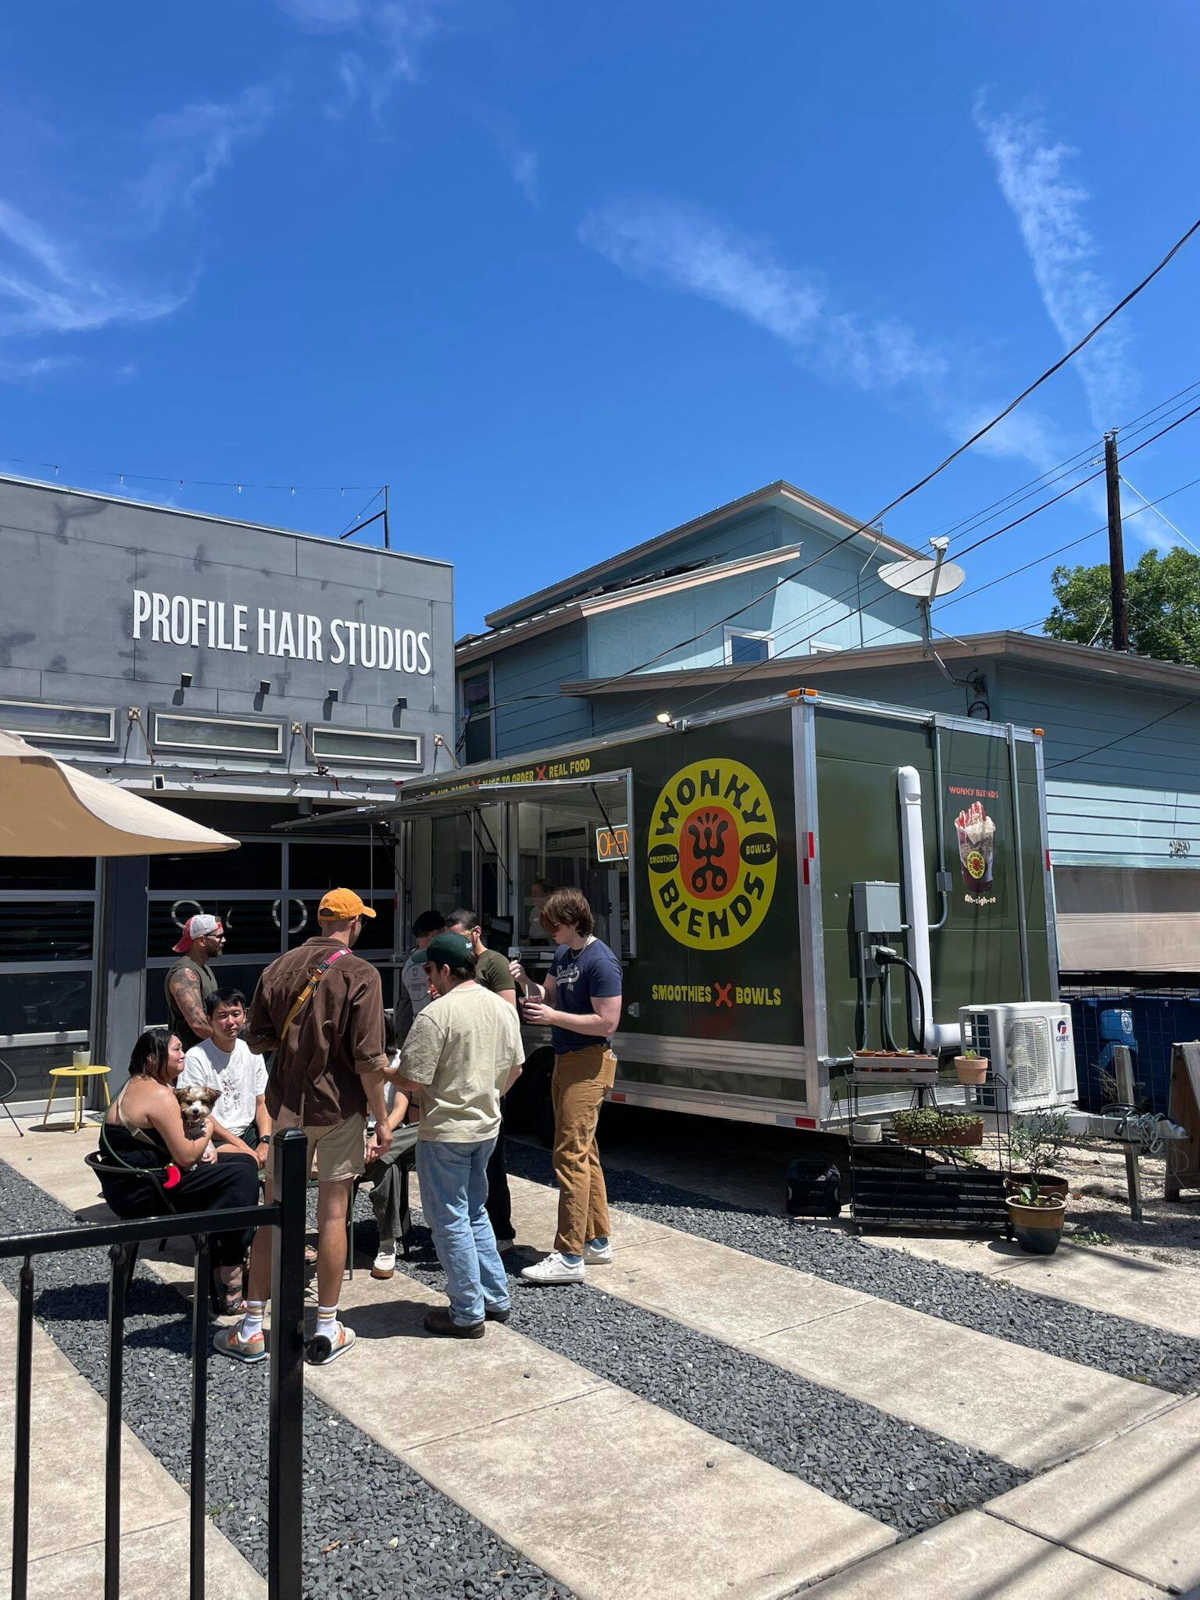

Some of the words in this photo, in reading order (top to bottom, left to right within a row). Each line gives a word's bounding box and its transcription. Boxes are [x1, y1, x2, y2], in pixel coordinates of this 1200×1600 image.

[132, 589, 248, 652] PROFILE
[257, 607, 324, 662] HAIR
[330, 618, 432, 675] STUDIOS
[512, 771, 534, 784] ORDER
[549, 763, 567, 778] REAL
[569, 758, 590, 773] FOOD
[656, 769, 767, 835] WONKY
[745, 843, 771, 856] BOWLS
[658, 872, 765, 939] BLENDS
[652, 984, 712, 1003] SMOOTHIES
[735, 986, 782, 1006] BOWLS
